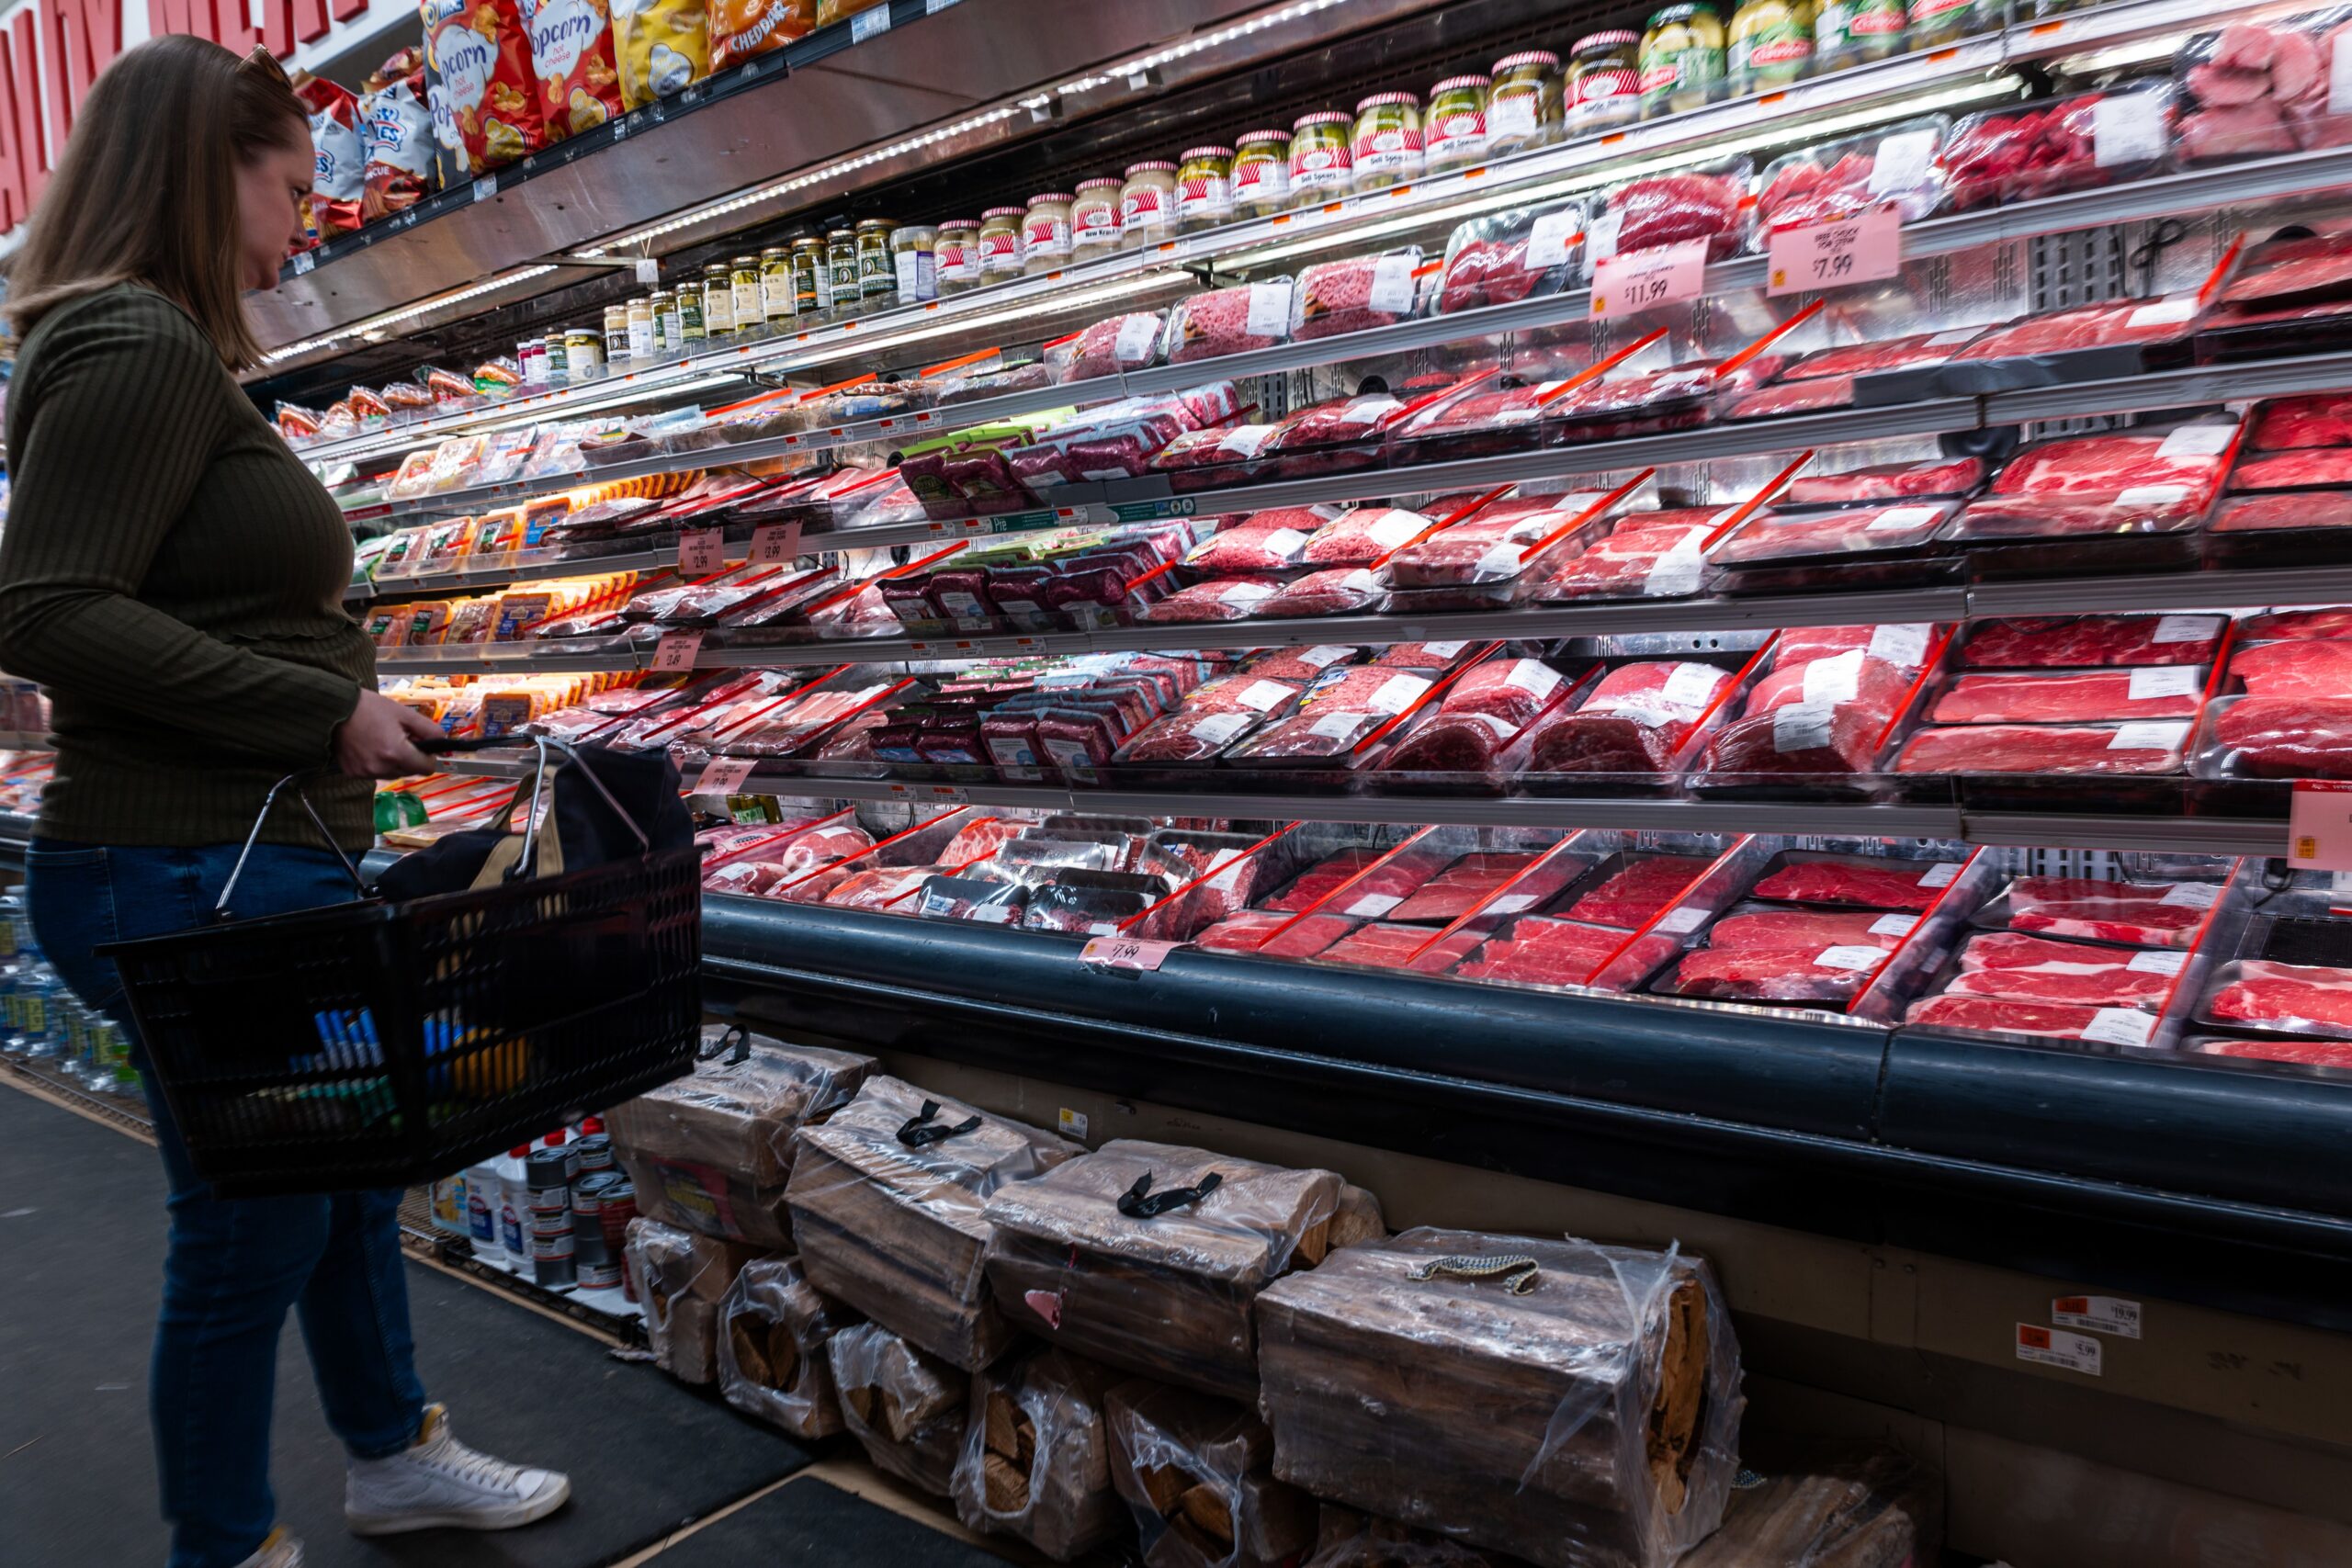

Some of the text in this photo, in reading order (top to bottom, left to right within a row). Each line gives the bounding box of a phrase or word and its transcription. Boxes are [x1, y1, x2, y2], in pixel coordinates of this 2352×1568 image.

[730, 1, 787, 52] CHEDDAR
[552, 44, 565, 54] hot
[544, 51, 571, 68] cheese
[1813, 253, 1852, 279] $7.99
[1624, 278, 1668, 305] $11.99
[1113, 942, 1140, 959] $7.99
[2110, 1305, 2138, 1322] $19.99
